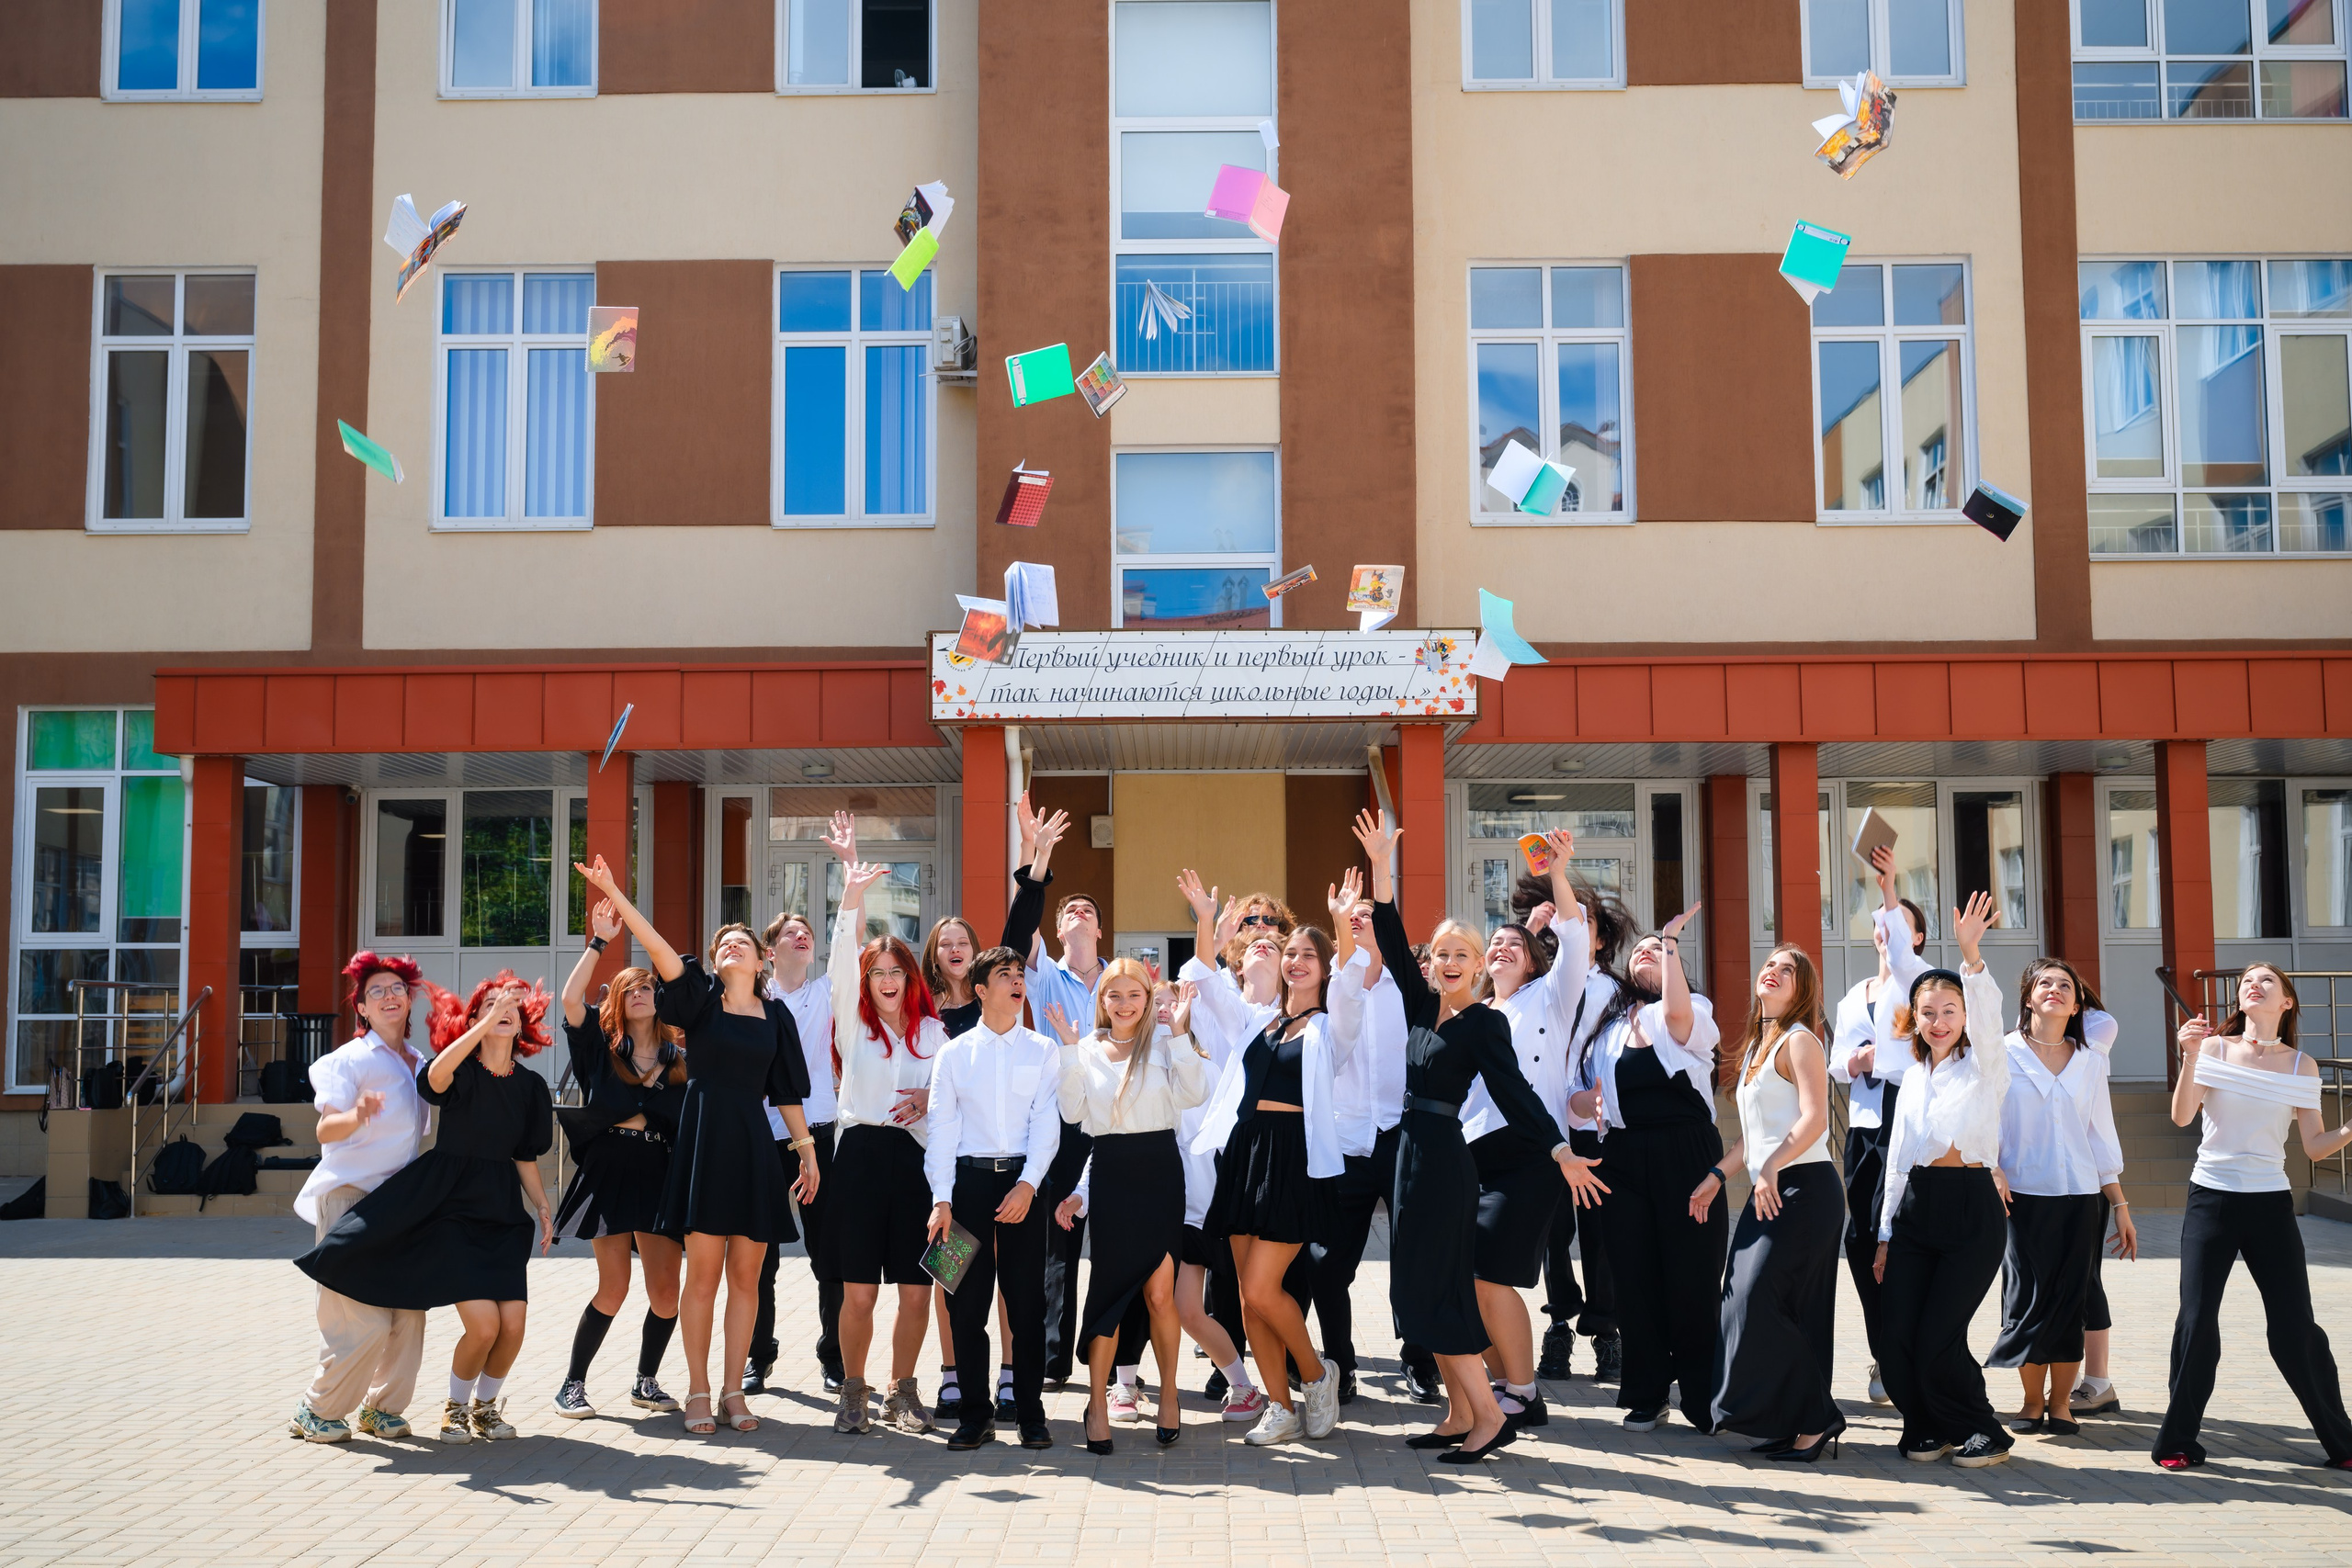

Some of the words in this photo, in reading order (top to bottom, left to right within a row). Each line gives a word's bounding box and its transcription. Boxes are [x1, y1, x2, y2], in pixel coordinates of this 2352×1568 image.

[1011, 644, 1100, 673] Первый
[1104, 643, 1204, 673] учебник
[1214, 651, 1231, 667] и
[1237, 643, 1329, 672] первый
[1330, 649, 1393, 672] урок
[989, 682, 1045, 703] так
[1049, 681, 1206, 703] начинаются
[1209, 685, 1333, 705] школьные
